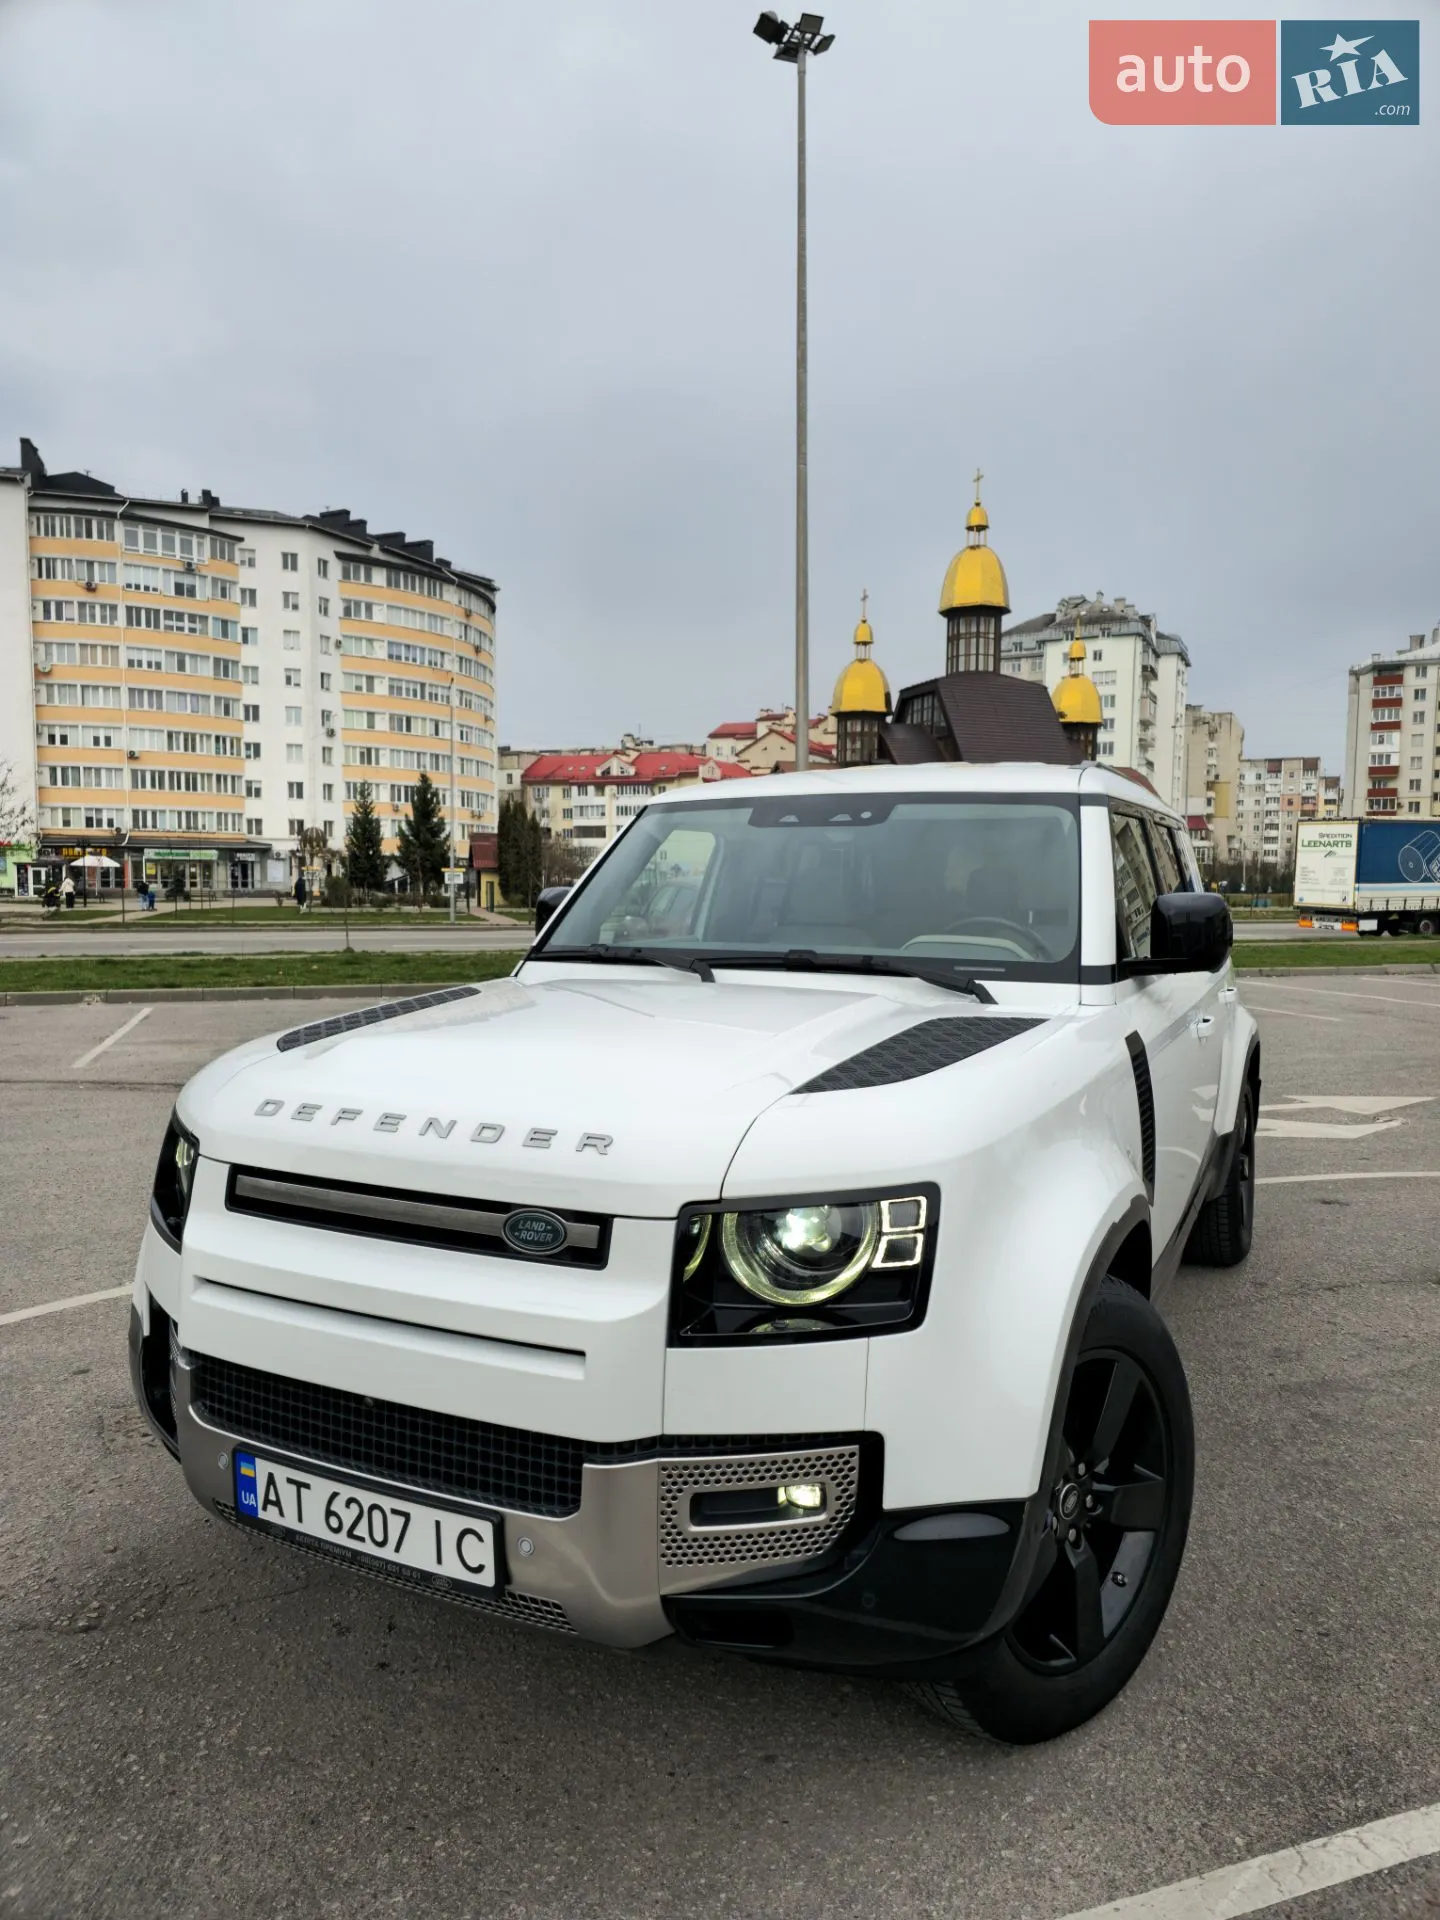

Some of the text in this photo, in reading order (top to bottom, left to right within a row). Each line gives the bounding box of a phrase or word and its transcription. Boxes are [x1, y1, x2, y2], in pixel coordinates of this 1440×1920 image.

[254, 1098, 614, 1155] DEFENDER
[518, 1220, 546, 1231] LAND
[519, 1230, 554, 1242] ROVER
[241, 1490, 257, 1508] UA
[262, 1471, 312, 1524] AT
[324, 1490, 412, 1554] 6207
[434, 1519, 486, 1575] IC
